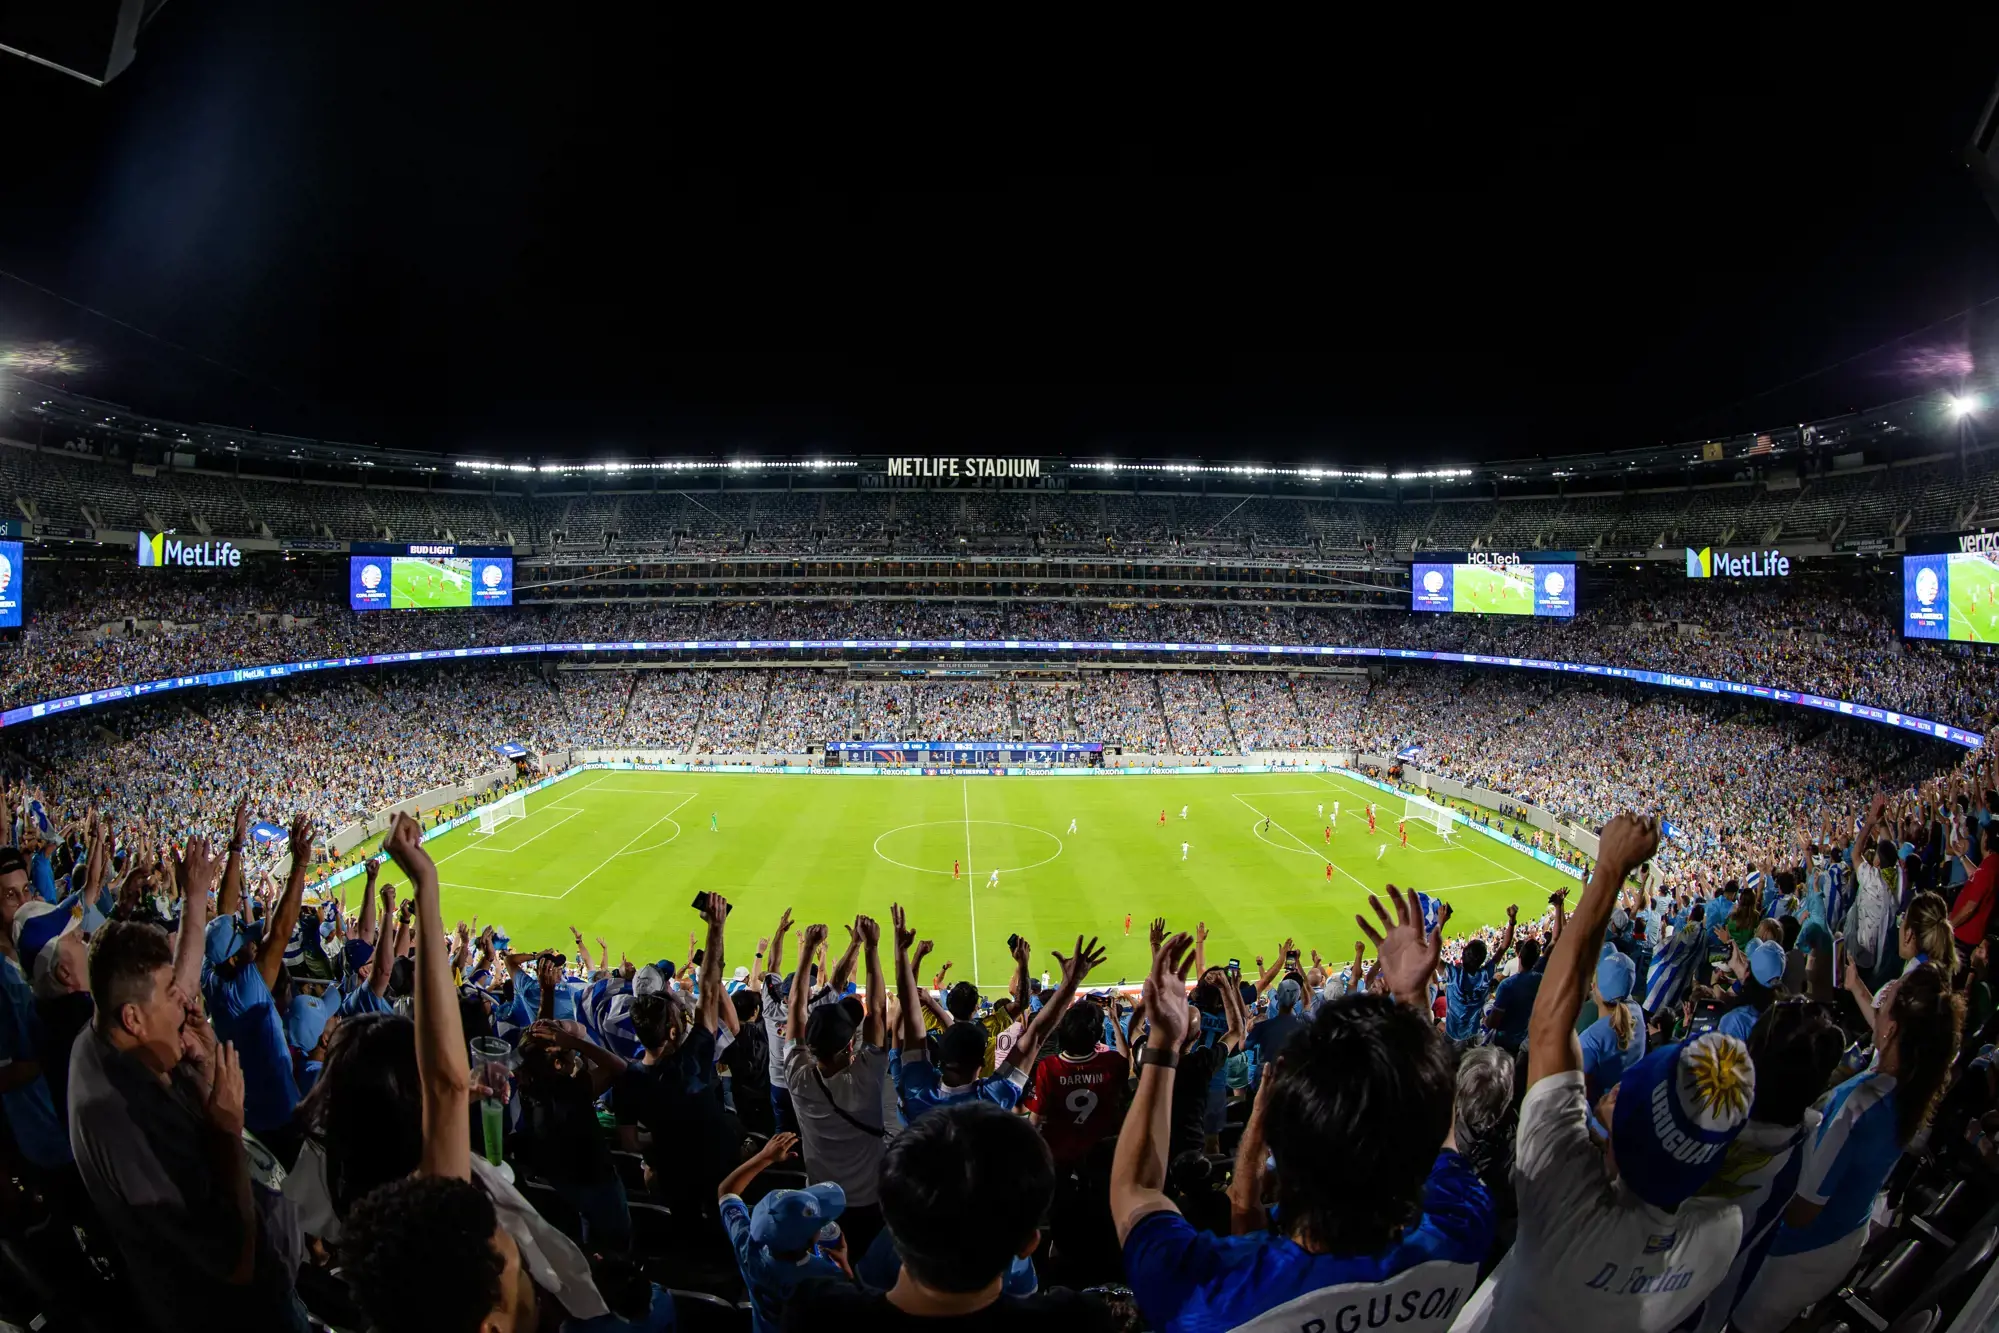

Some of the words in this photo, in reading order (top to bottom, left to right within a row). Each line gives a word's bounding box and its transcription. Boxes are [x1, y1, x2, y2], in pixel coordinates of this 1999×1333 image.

[888, 458, 959, 477] METLIFE
[965, 458, 1040, 478] STADIUM
[164, 540, 241, 566] MetLife
[410, 546, 428, 554] BUD
[429, 547, 454, 555] LIGHT
[1468, 552, 1520, 564] HCLTech
[1713, 550, 1789, 576] MetLife
[242, 669, 264, 679] MetLife
[1671, 676, 1693, 687] MetLife
[1918, 723, 1930, 731] ULTRA
[1965, 735, 1978, 745] ULTRA
[755, 766, 784, 774] Rexona
[811, 767, 840, 775] Rexona
[452, 814, 472, 828] Rexona
[1469, 820, 1488, 834] Rexona
[1511, 839, 1534, 857] Rexona
[1555, 859, 1582, 880] Rexona
[1060, 1073, 1103, 1085] DARWIN
[1065, 1088, 1098, 1124] 9
[1652, 1079, 1727, 1165] URUGUAY
[1584, 1262, 1609, 1292] D.
[1615, 1264, 1694, 1295] Forlán
